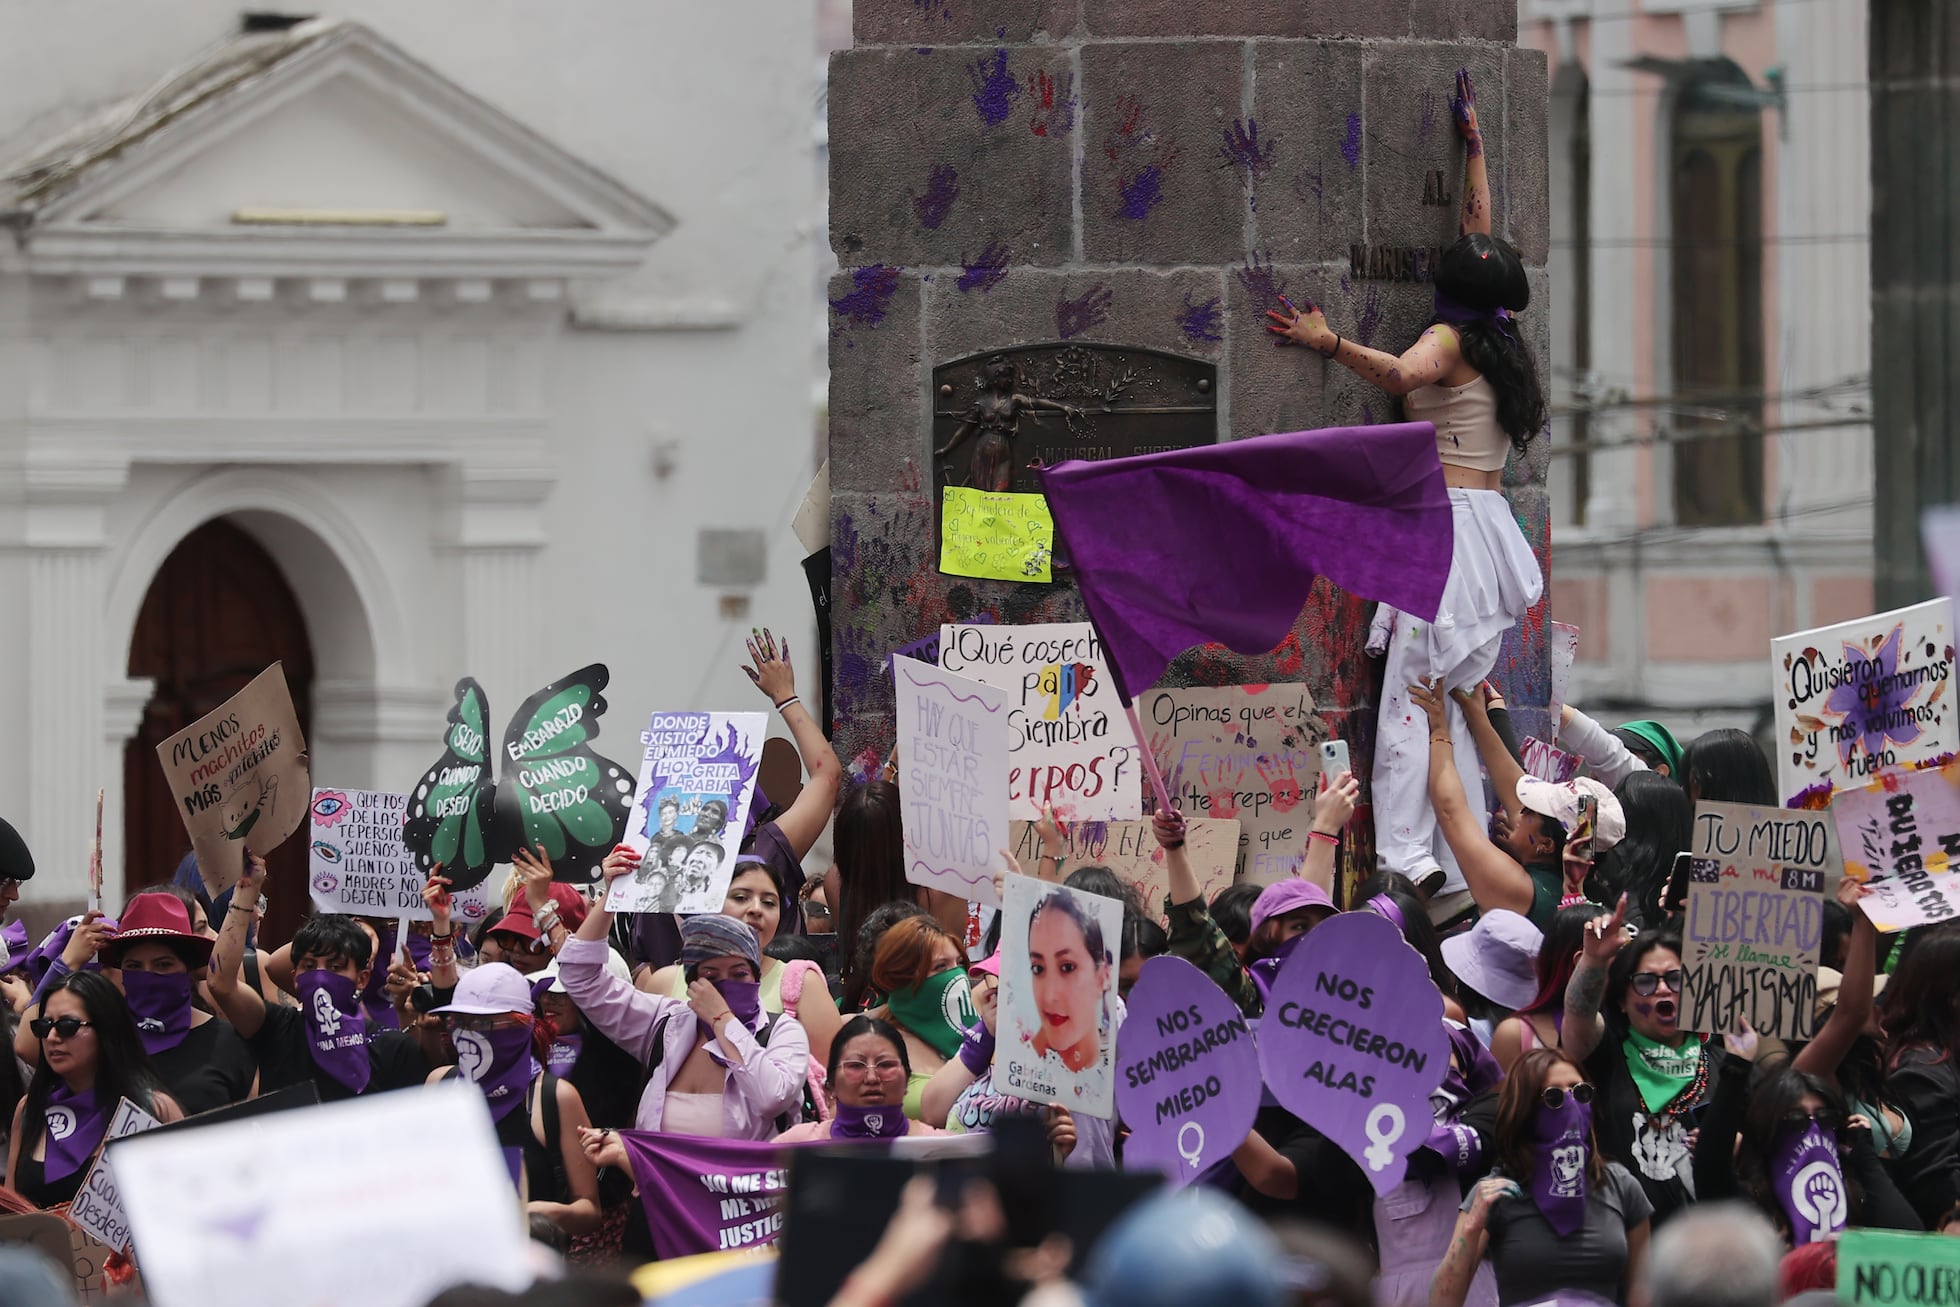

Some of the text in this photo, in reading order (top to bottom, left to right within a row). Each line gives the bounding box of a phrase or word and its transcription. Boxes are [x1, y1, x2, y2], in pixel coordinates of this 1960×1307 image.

[943, 626, 1014, 671] ¿Qué
[1791, 656, 1884, 702] Quisieron
[1858, 660, 1948, 709] quemarnos
[653, 716, 708, 729] DONDE
[1153, 693, 1231, 737] Opinas
[1240, 705, 1275, 735] que
[173, 713, 240, 767] MENOS
[454, 724, 482, 756] SEXO
[506, 703, 583, 761] EMBARAZO
[640, 728, 698, 745] EXISTIÓ
[949, 713, 983, 756] QUE
[1805, 731, 1817, 759] y
[1830, 721, 1857, 743] nos
[667, 745, 720, 758] MIEDO
[912, 736, 979, 786] ESTAR
[438, 765, 480, 786] CUANDO
[519, 756, 587, 788] CUANDO
[660, 761, 738, 778] HOY GRITA
[668, 774, 730, 792] LA RABIA
[184, 784, 222, 816] MÁS
[357, 792, 379, 809] QUE
[436, 796, 469, 818] DESEO
[529, 784, 588, 814] DECIDO
[1188, 785, 1212, 810] te
[352, 810, 369, 824] DE
[373, 812, 399, 826] LAS
[357, 825, 403, 842] PERSIG
[345, 840, 398, 858] SUEÑOS
[910, 802, 990, 867] JUNTAS
[1260, 828, 1292, 849] que
[1698, 814, 1740, 855] TU
[1749, 820, 1826, 866] MIEDO
[345, 859, 416, 875] LLANTO DE
[345, 874, 419, 892] MADRES NO
[341, 888, 386, 907] DEJEN
[1690, 890, 1823, 951] LIBERTAD
[1315, 972, 1374, 1009] NOS
[1676, 962, 1817, 1039] MACHISMO
[1156, 1005, 1202, 1037] NOS
[1126, 1014, 1246, 1088] SEMBRARON
[1278, 1003, 1427, 1073] CRECIERON
[1304, 1061, 1376, 1098] ALAS
[1155, 1076, 1220, 1125] MIEDO
[731, 1172, 760, 1194] ME
[720, 1198, 751, 1220] ME
[1855, 1262, 1960, 1307] NO QUER
